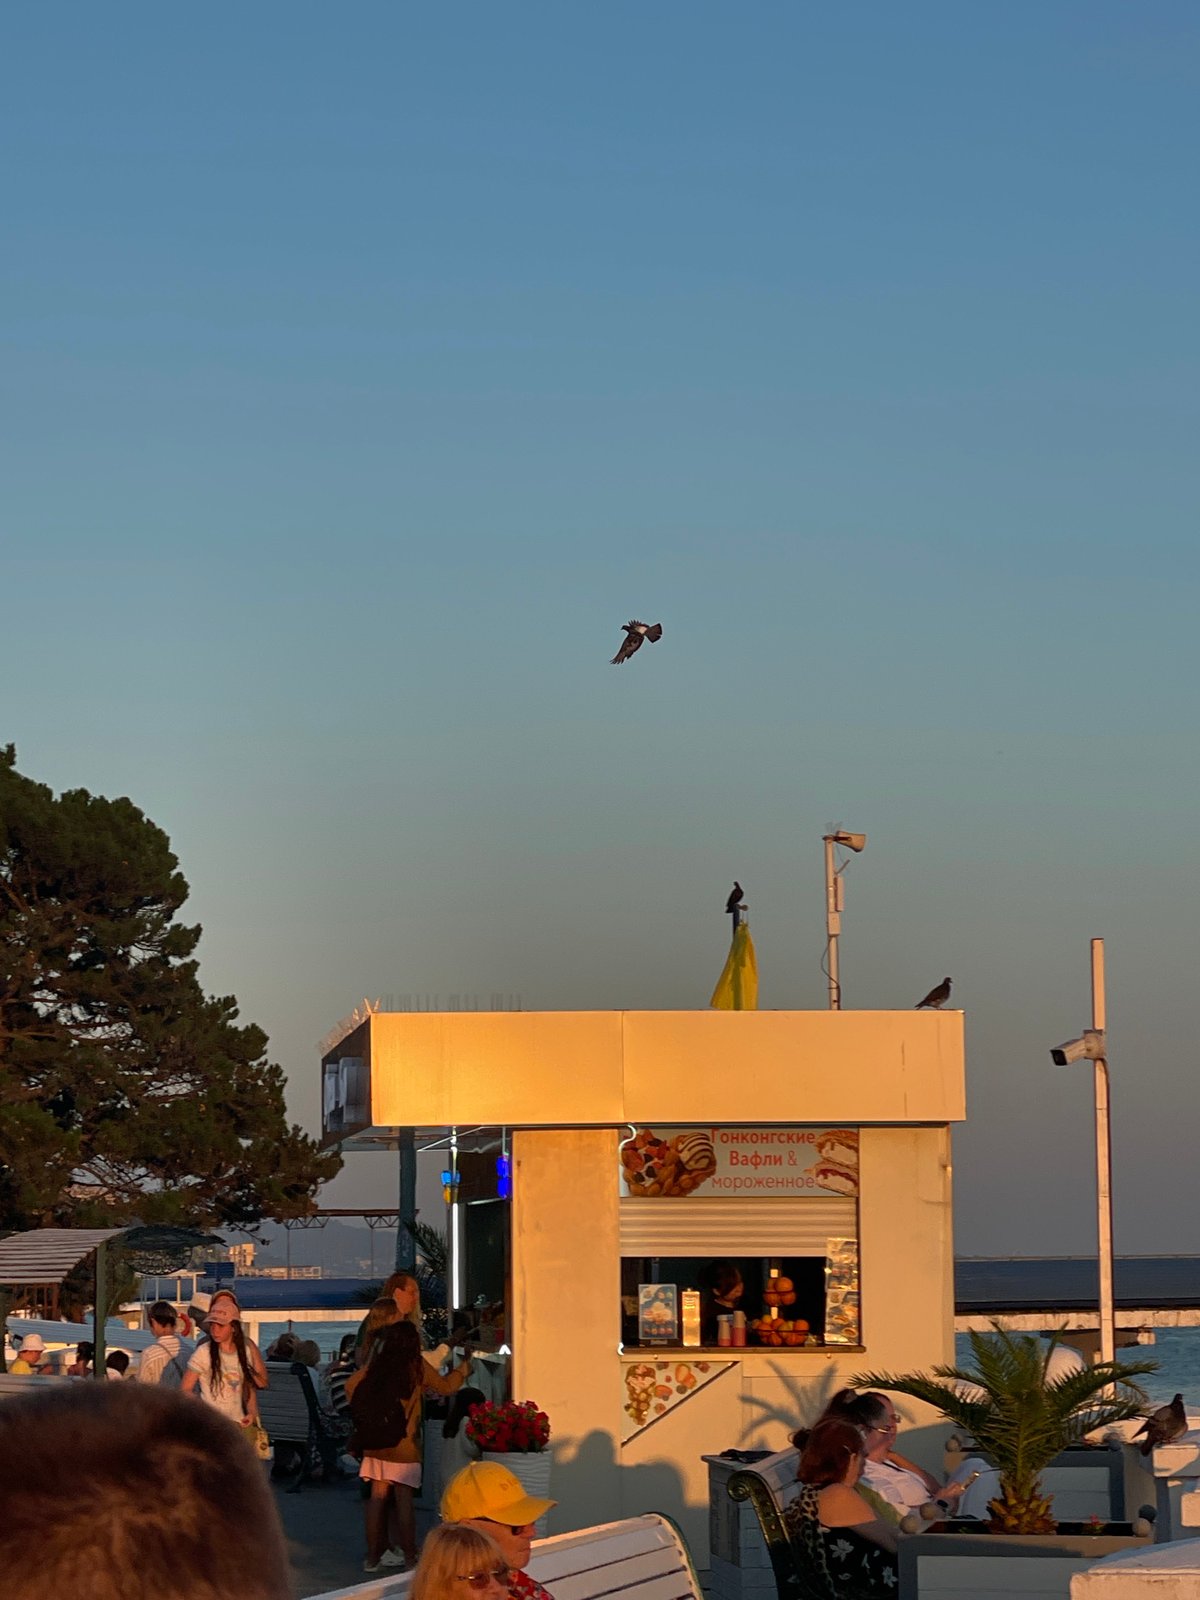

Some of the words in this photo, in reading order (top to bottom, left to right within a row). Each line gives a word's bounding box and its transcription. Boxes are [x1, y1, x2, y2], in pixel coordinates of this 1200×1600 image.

[711, 1128, 815, 1144] Гонконгские
[730, 1150, 782, 1170] Вафли
[787, 1150, 798, 1166] &
[711, 1176, 815, 1192] мороженное
